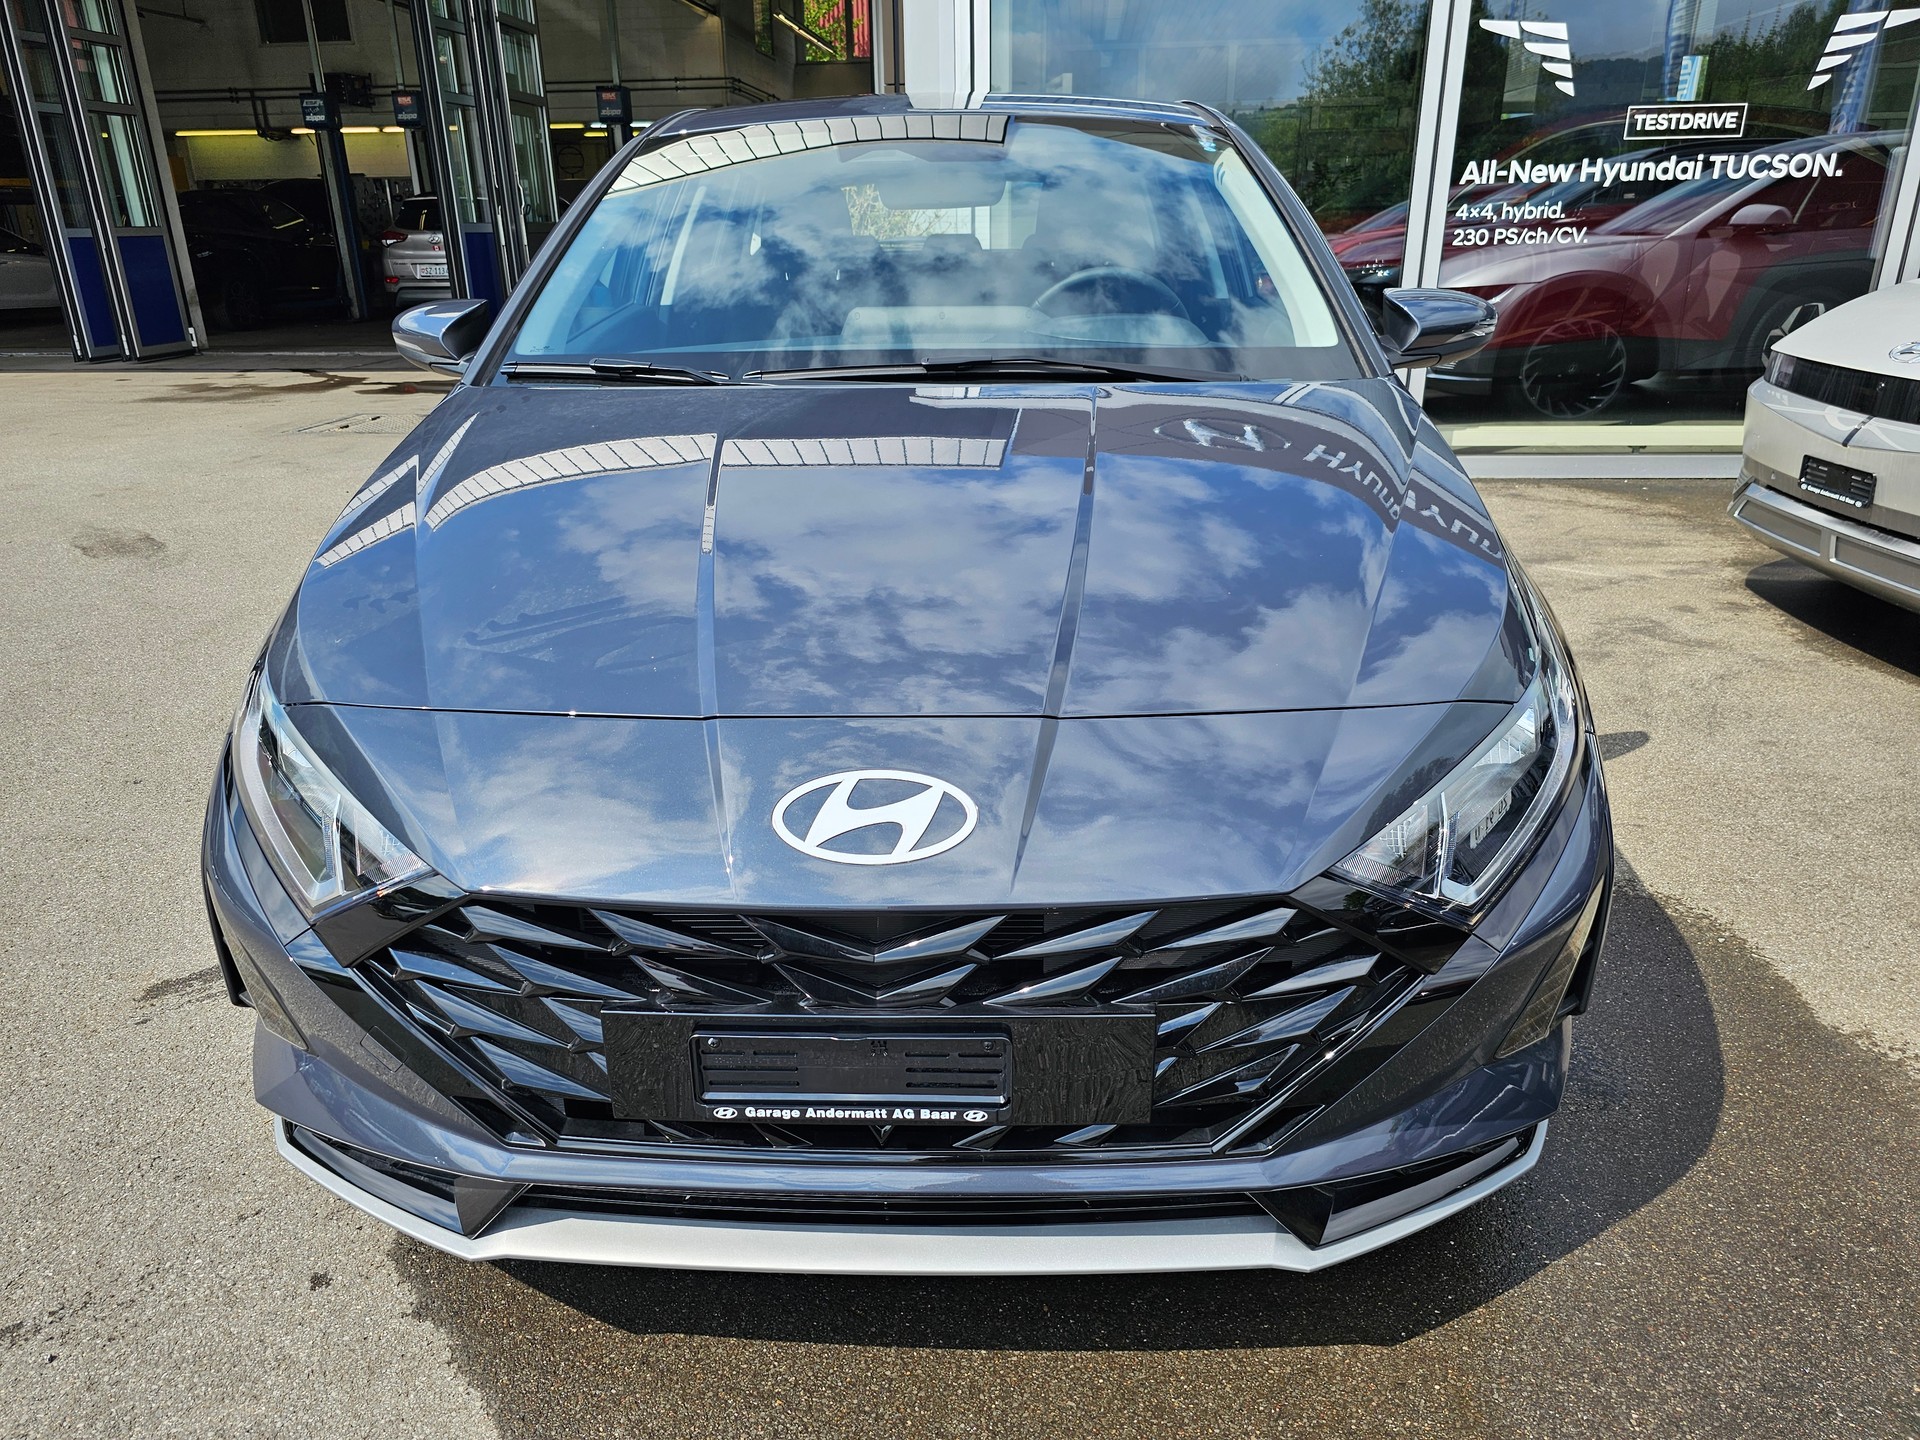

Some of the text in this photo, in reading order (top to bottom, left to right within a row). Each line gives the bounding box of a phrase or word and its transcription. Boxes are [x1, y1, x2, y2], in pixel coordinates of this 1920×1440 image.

[1633, 112, 1739, 131] TESTDRIVE
[1459, 152, 1844, 188] All-New Hyundai TUCSON.
[1500, 200, 1566, 224] hybrid.
[1451, 226, 1589, 246] 230 PS/ch/CV.
[744, 1106, 957, 1120] Garage Andermatt AG Baar
